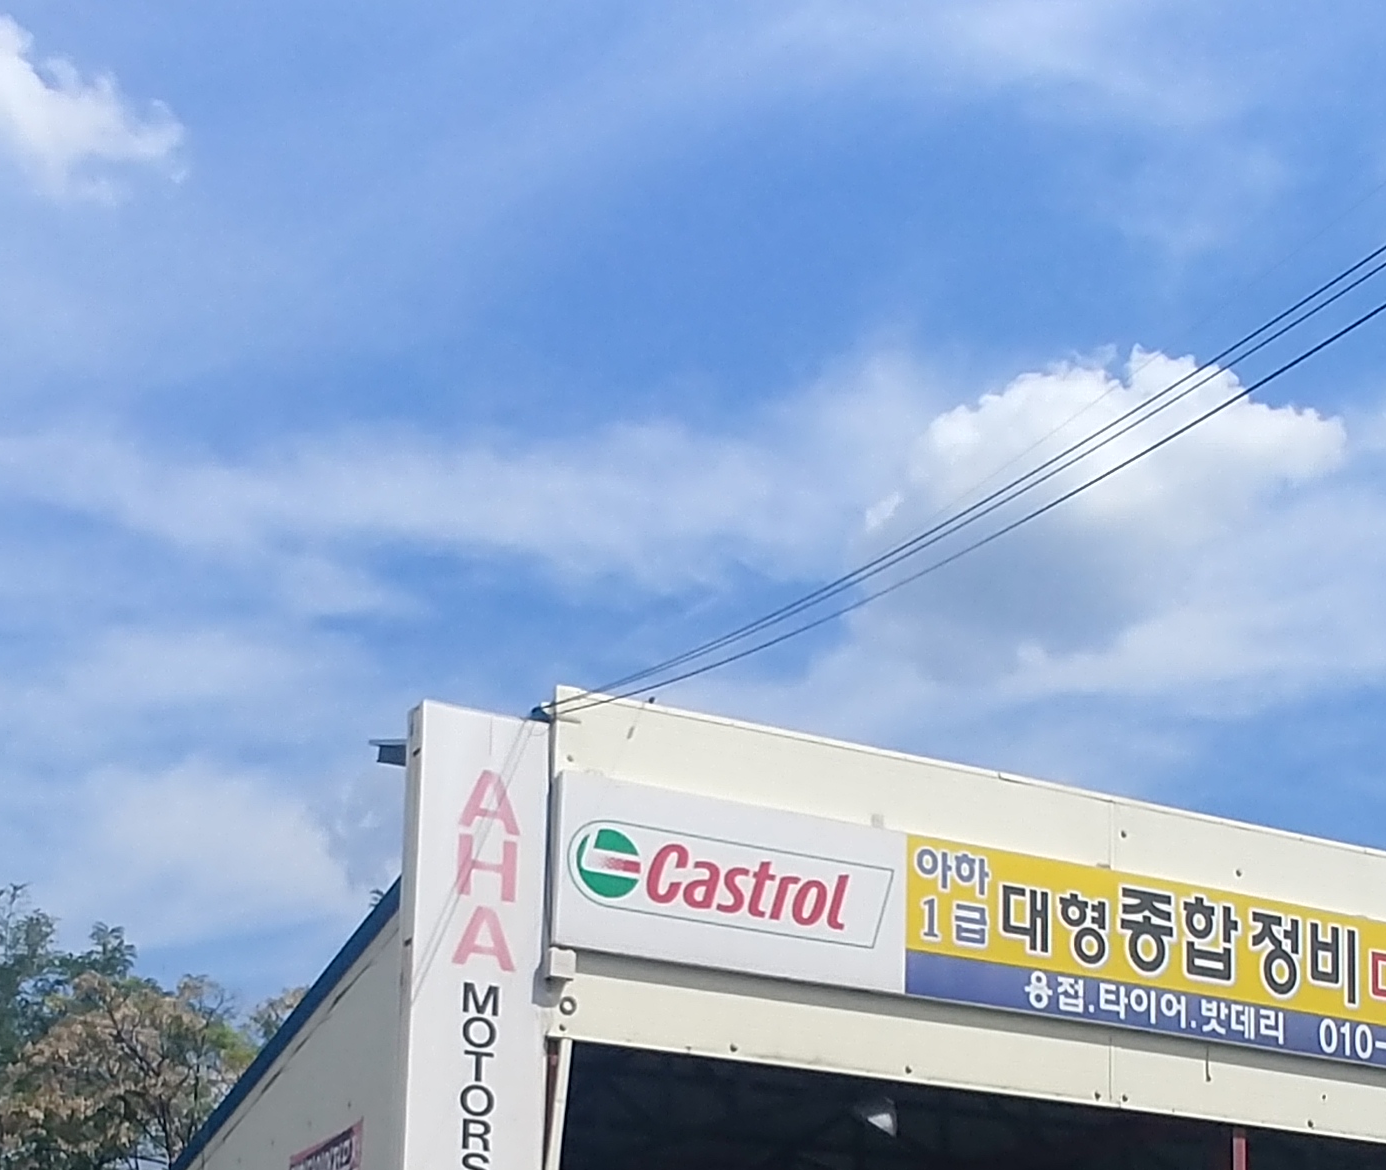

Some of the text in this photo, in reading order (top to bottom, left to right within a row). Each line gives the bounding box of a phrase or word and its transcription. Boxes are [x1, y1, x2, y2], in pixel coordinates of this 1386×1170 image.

[451, 769, 521, 973] AHA
[646, 843, 850, 930] Castrol
[915, 847, 990, 897] 아하
[921, 897, 988, 946] 1급
